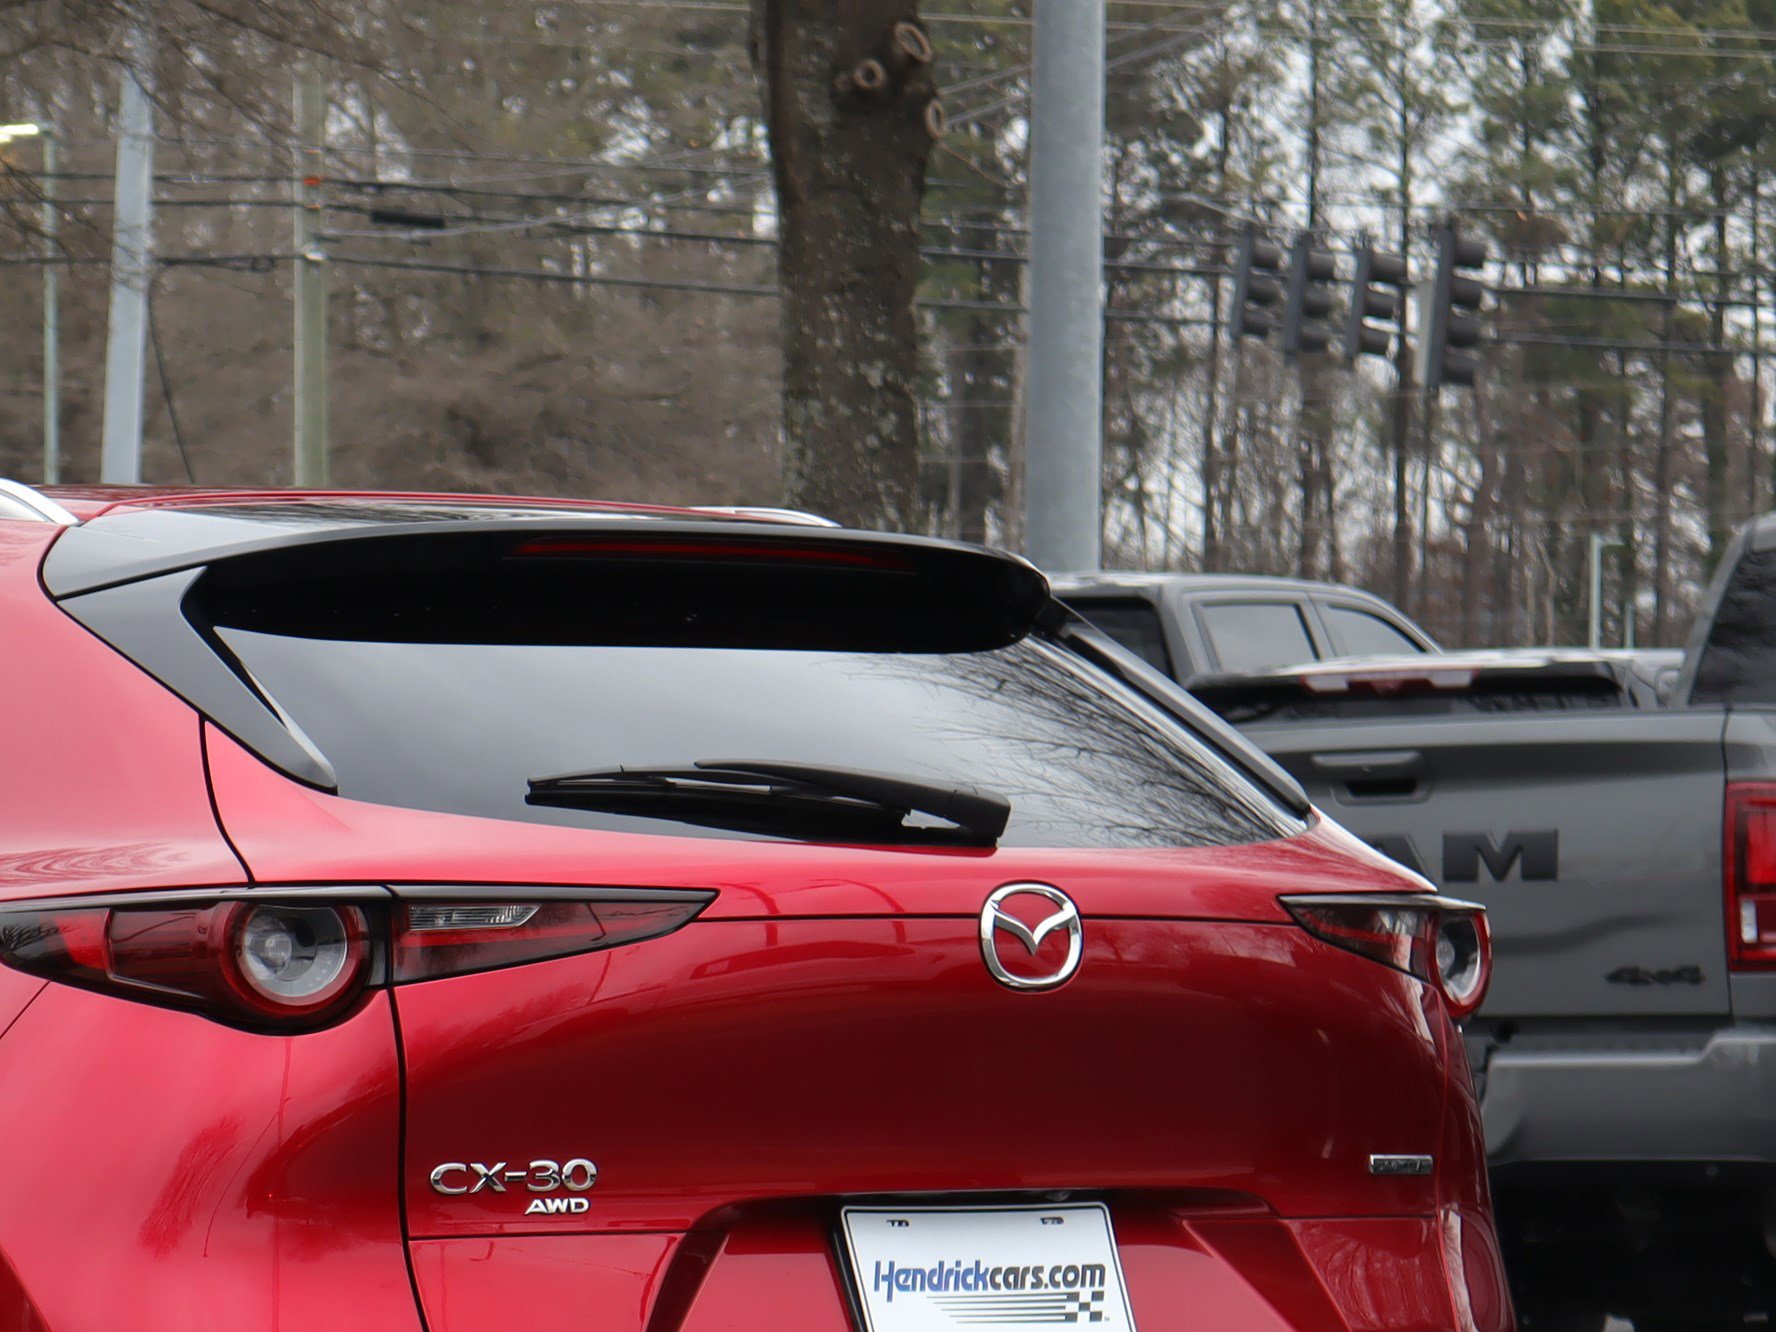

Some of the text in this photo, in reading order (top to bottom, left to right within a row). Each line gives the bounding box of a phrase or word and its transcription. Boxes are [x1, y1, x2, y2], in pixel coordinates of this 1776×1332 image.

[430, 1158, 597, 1195] CX-30
[524, 1197, 590, 1215] AWD
[874, 1259, 1106, 1303] Hendrickcars.com
